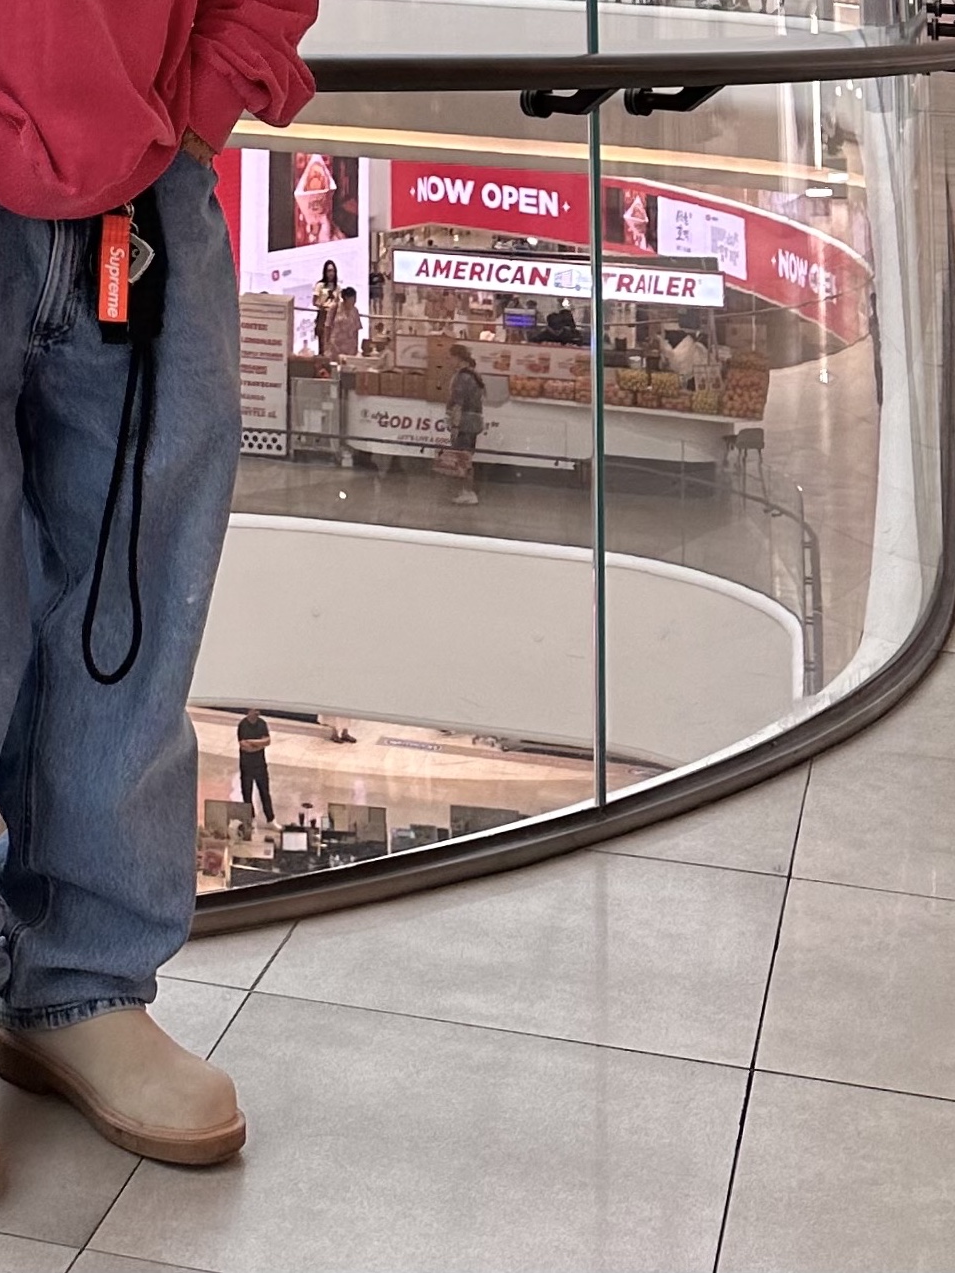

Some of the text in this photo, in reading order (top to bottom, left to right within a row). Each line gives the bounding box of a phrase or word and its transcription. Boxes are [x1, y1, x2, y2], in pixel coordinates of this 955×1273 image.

[416, 175, 559, 217] NOW OPEN
[104, 246, 126, 318] Supreme
[415, 258, 552, 287] AMERICAN
[778, 249, 808, 288] NOW
